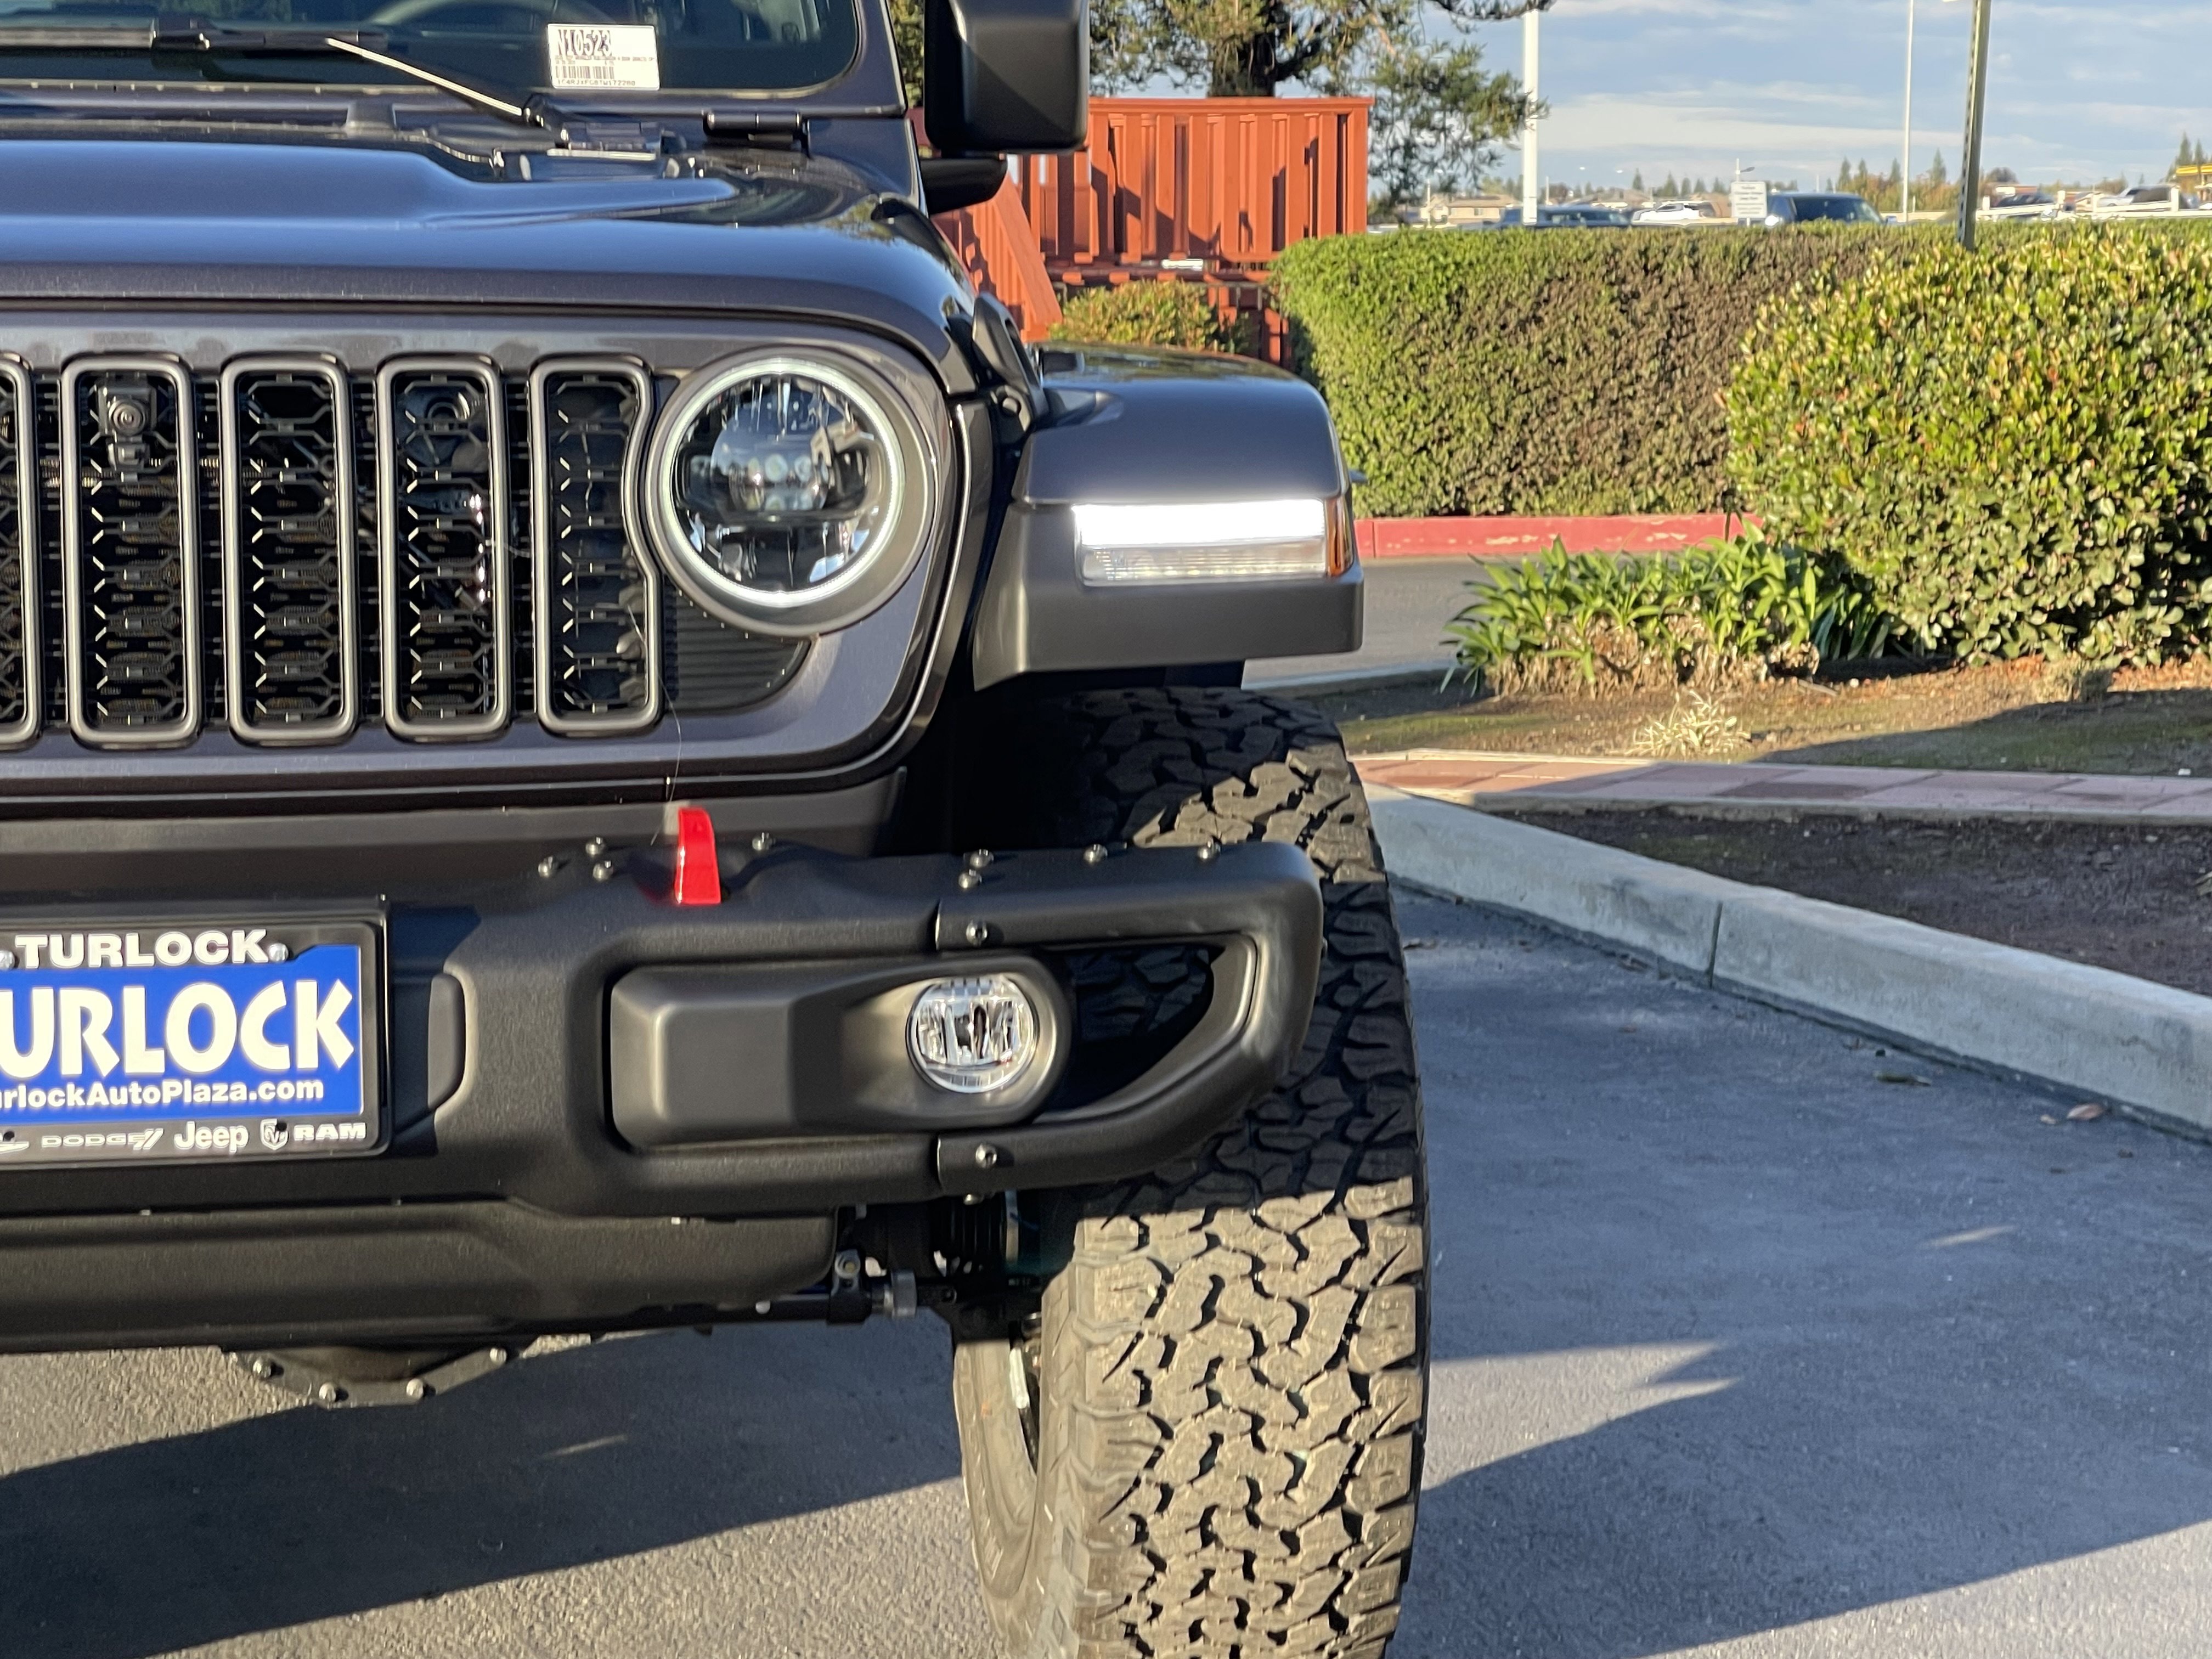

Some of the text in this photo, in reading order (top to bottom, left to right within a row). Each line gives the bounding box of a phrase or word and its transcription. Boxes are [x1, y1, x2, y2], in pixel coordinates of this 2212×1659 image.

[15, 929, 269, 968] TURLOCK
[0, 979, 354, 1078] URLOCK
[0, 1079, 324, 1108] rlockAutoPlaza.com
[42, 1121, 366, 1153] DODGE Jeep RAM
